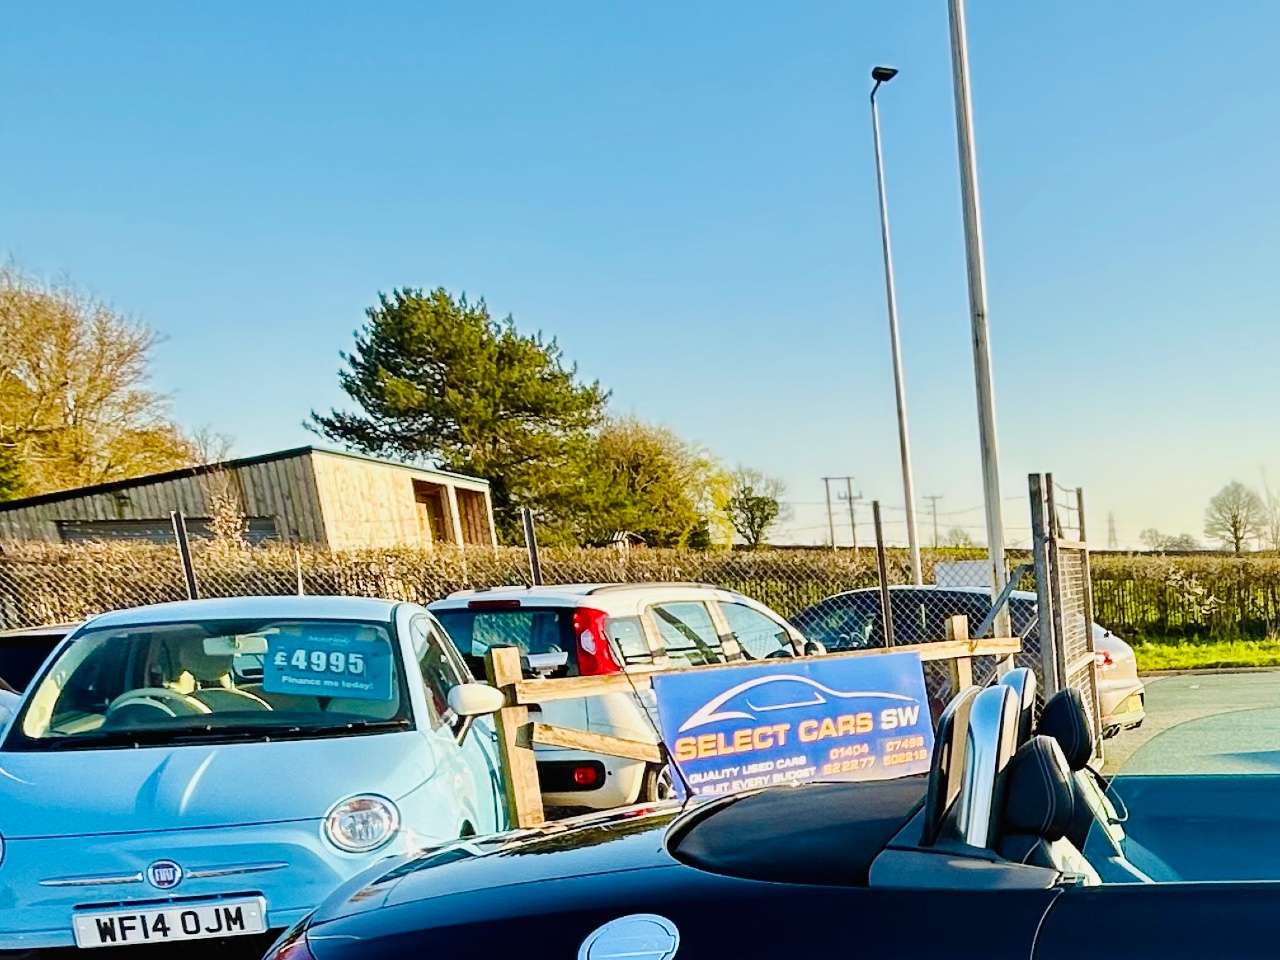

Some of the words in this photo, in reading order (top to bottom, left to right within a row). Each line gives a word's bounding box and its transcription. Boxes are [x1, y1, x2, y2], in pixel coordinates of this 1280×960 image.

[274, 649, 365, 674] £4995
[281, 675, 321, 686] Finance
[323, 680, 339, 688] me
[341, 681, 374, 690] today!
[674, 723, 790, 762] SELECT
[798, 712, 873, 743] CARS
[881, 706, 920, 731] SW
[689, 766, 740, 785] QUALITY
[743, 760, 775, 775] USED
[776, 755, 807, 769] CARS
[732, 775, 772, 793] EVERY
[96, 913, 171, 943] WF14
[181, 906, 245, 935] OJM
